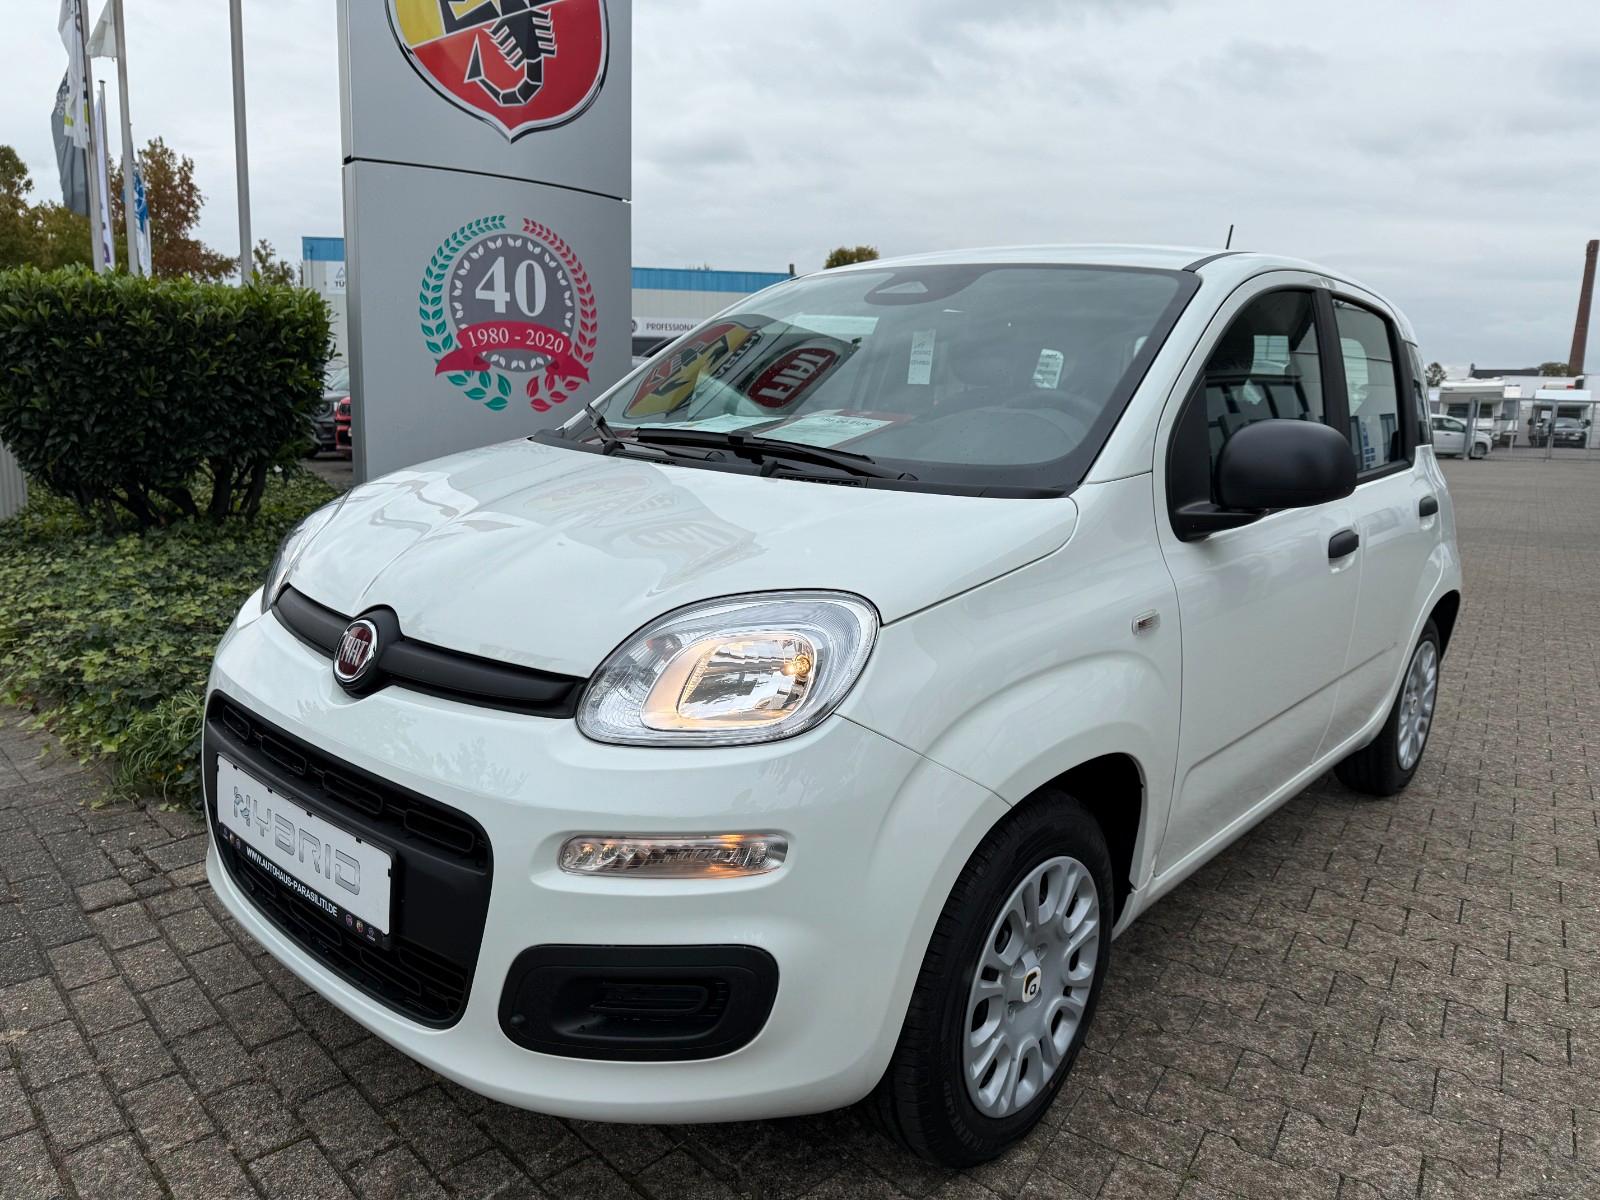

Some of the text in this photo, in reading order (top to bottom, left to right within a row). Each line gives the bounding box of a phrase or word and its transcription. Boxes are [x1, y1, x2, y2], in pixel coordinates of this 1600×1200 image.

[475, 256, 547, 317] 40
[468, 327, 509, 348] 1980
[526, 329, 564, 353] 2020
[338, 633, 369, 667] FIAT
[233, 785, 361, 896] HYBRID
[246, 845, 338, 918] WWW.AUTOHAUS-PARASILITI.DE
